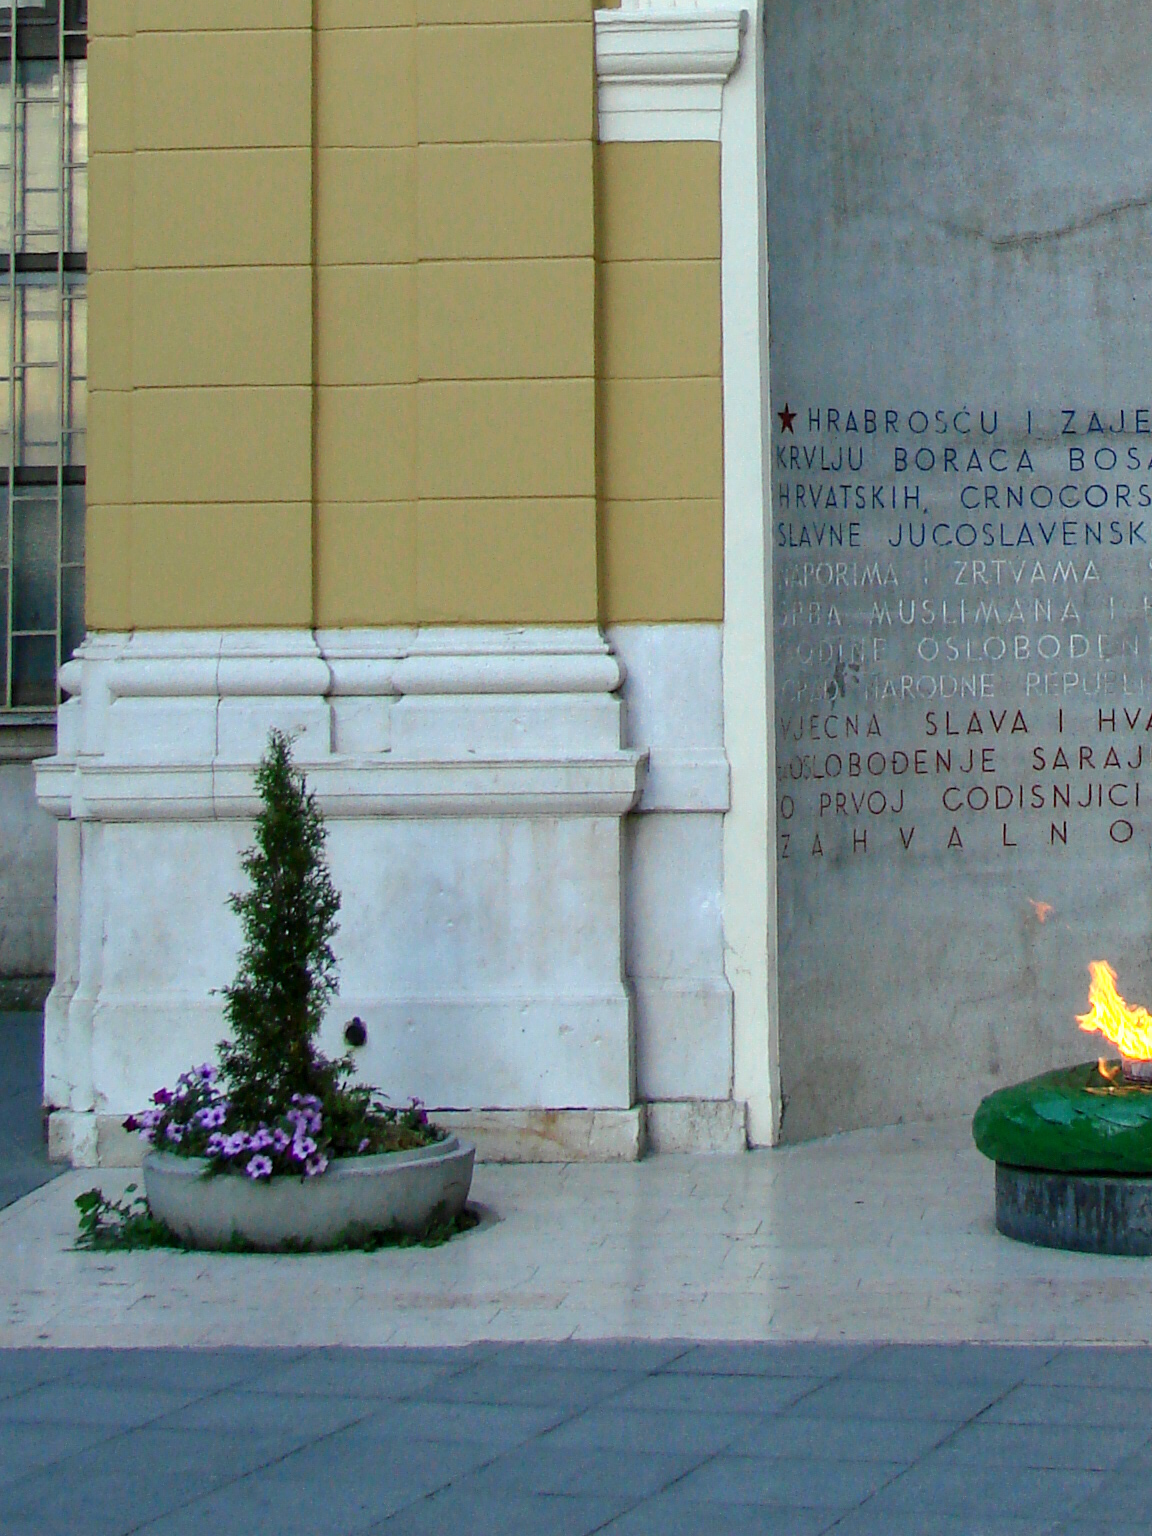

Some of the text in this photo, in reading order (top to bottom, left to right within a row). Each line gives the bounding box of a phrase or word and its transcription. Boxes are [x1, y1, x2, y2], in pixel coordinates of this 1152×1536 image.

[1026, 410, 1033, 435] I
[776, 445, 864, 472] KRVLJU
[894, 447, 1034, 473] BORACA
[778, 521, 862, 548] SLAVNE
[869, 597, 1080, 626] MUSLIMANA
[1109, 596, 1115, 620] I
[783, 637, 888, 664] ODINE
[925, 708, 1028, 736] SLAVA
[1058, 708, 1064, 733] I
[780, 795, 795, 820] O
[819, 789, 904, 817] PRVOJ
